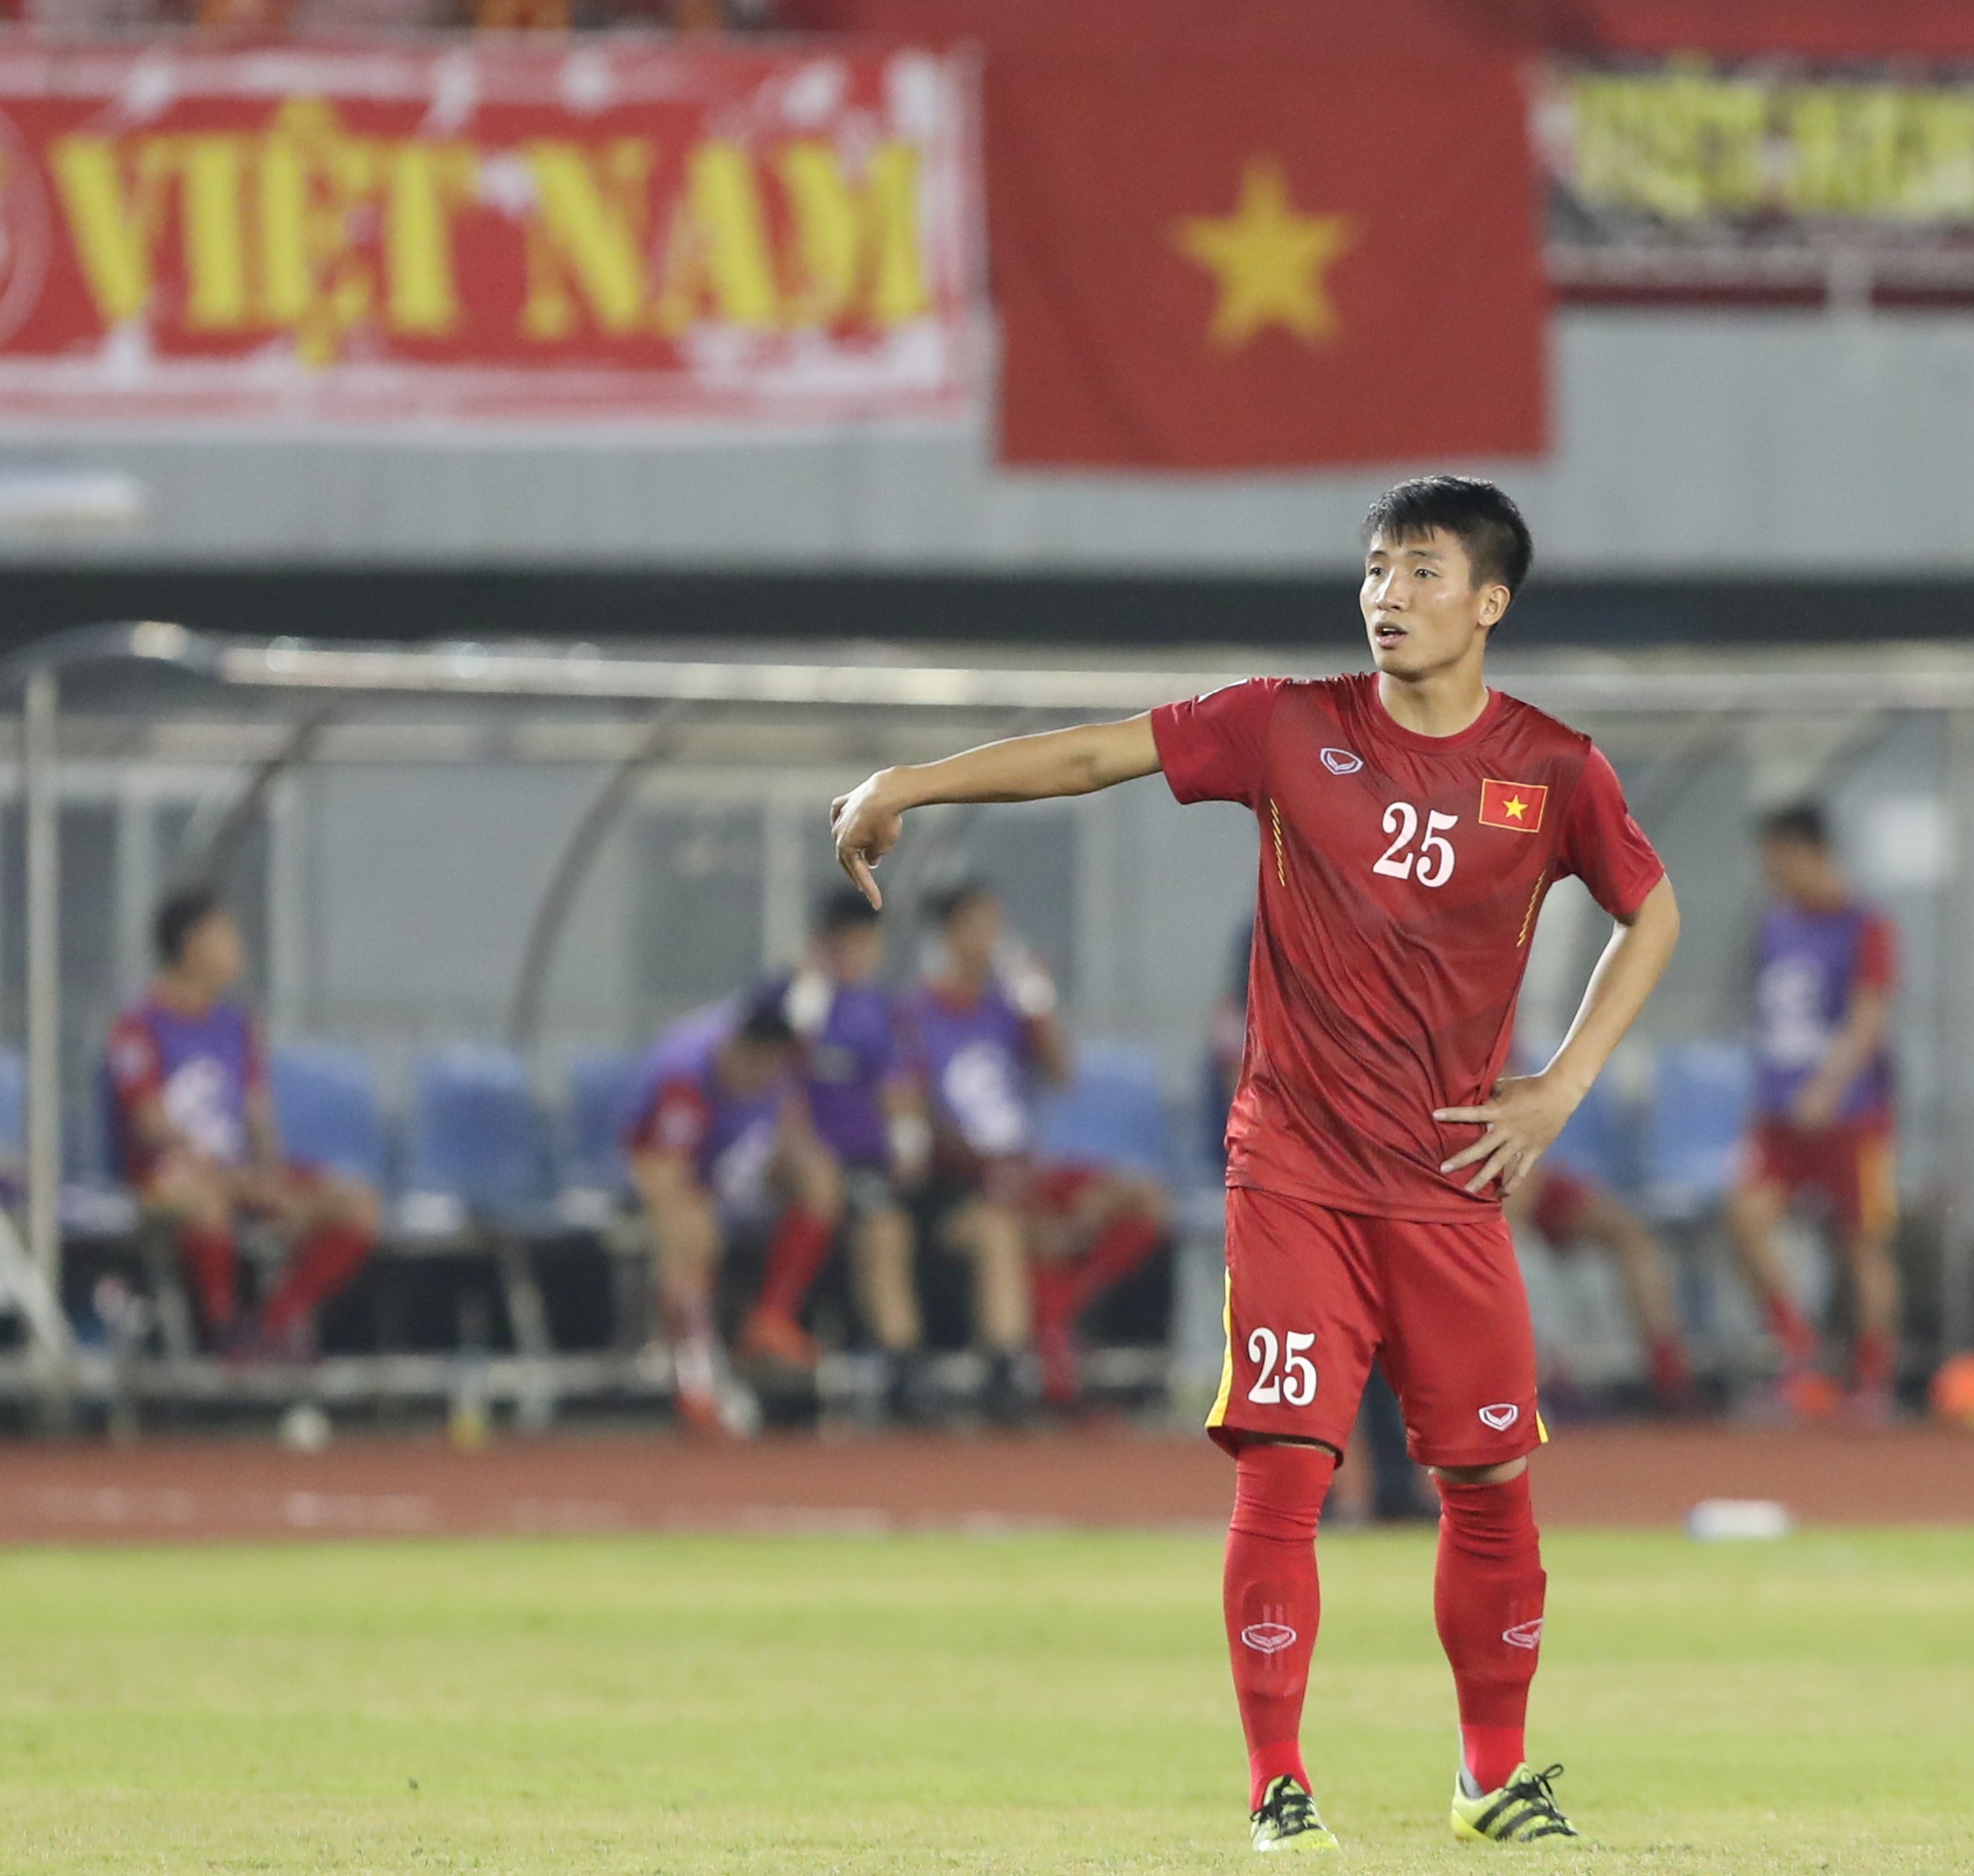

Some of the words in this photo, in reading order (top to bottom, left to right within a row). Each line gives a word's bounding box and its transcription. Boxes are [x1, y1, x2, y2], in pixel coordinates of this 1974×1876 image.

[51, 98, 479, 366] VIỆT
[521, 138, 928, 339] NAM
[1373, 801, 1459, 888] 25
[1248, 1327, 1318, 1407] 25
